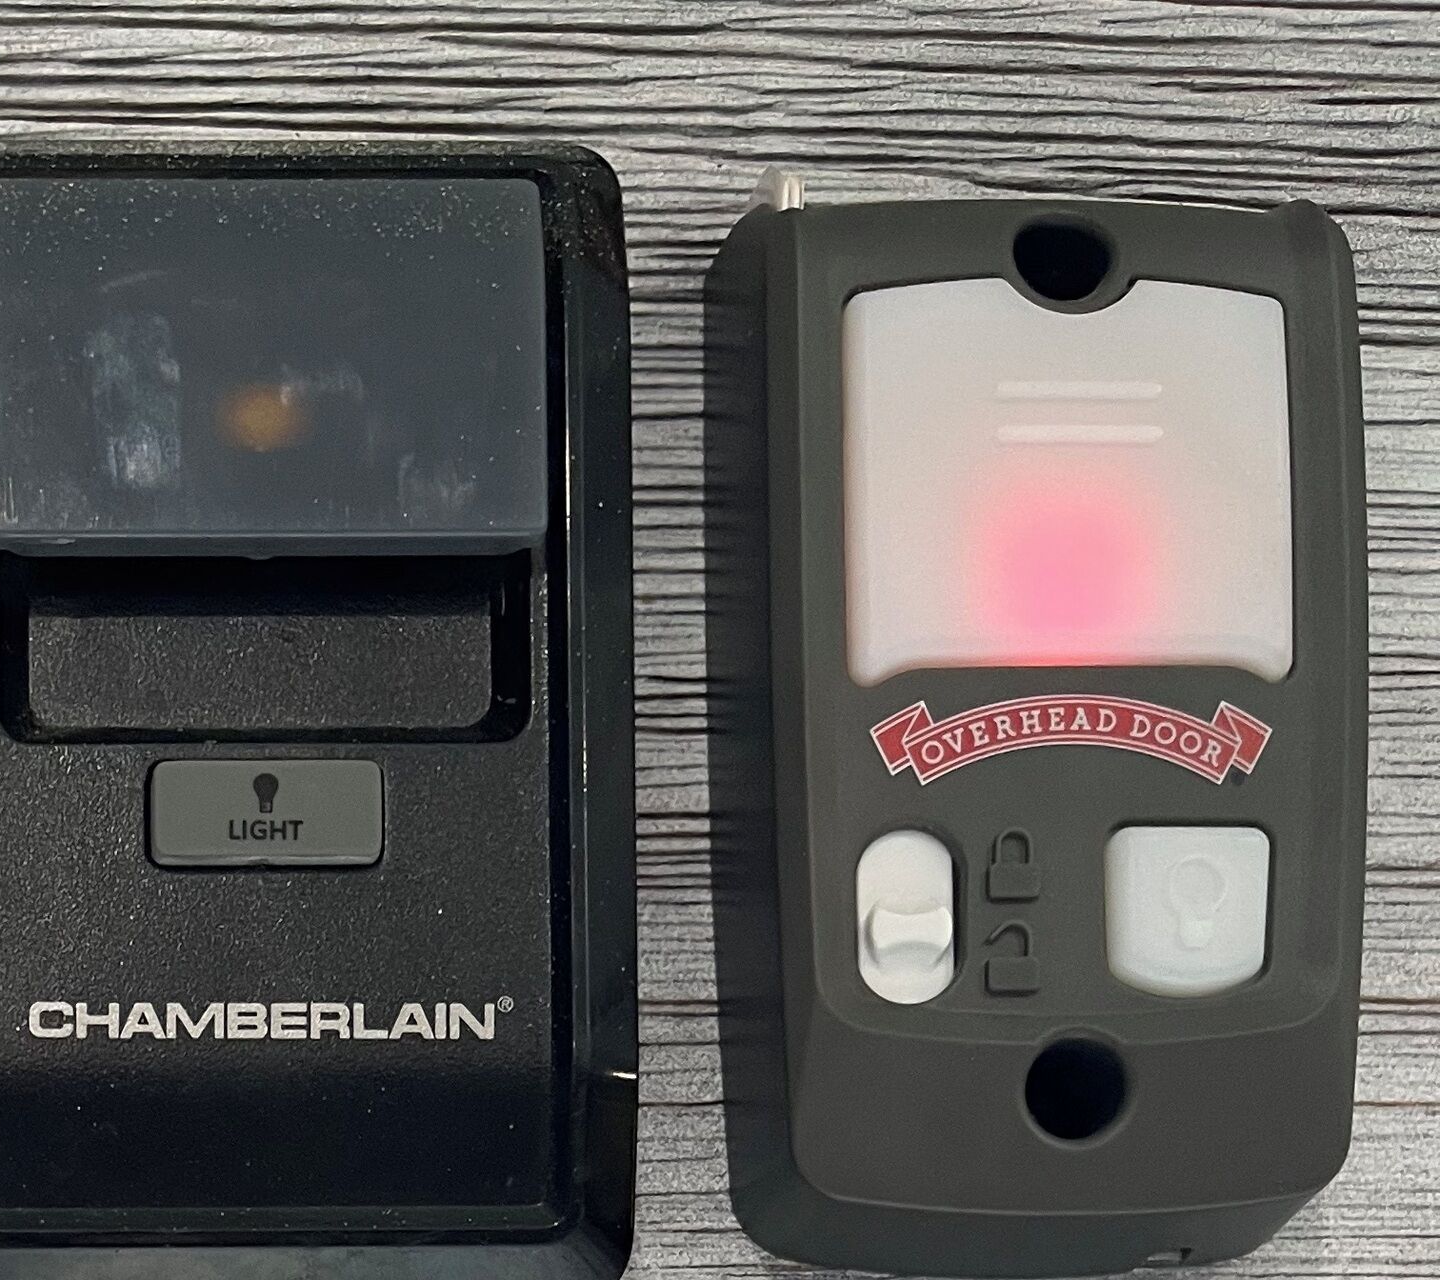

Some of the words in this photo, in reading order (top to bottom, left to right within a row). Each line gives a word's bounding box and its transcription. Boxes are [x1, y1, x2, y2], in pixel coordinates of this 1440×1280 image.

[921, 706, 1118, 765] OVERHEAD
[1129, 714, 1224, 768] DOOR
[227, 819, 304, 841] LIGHT
